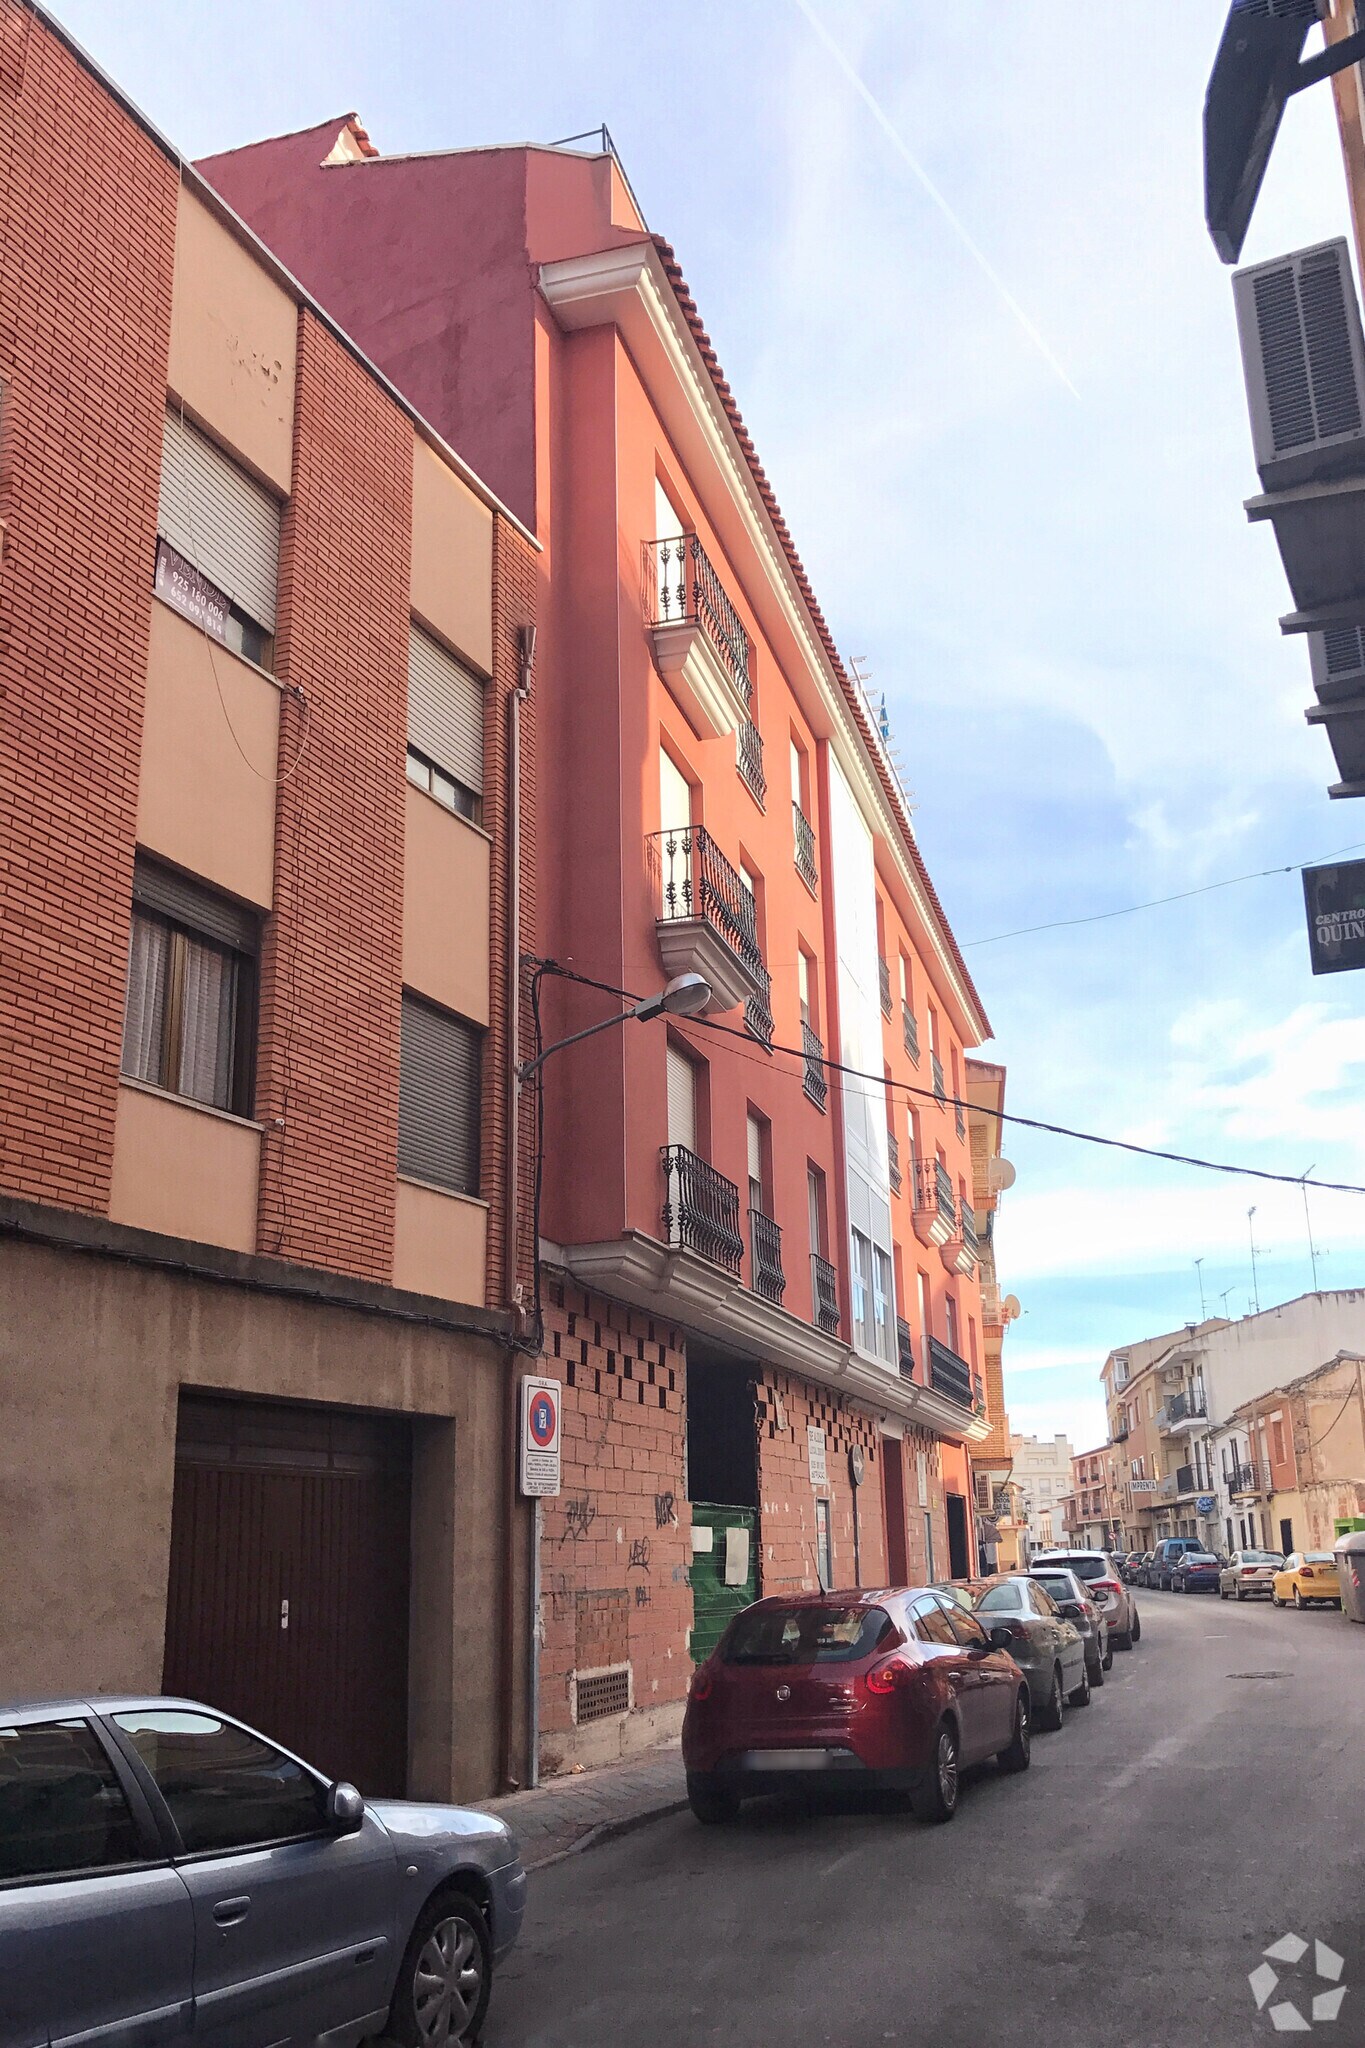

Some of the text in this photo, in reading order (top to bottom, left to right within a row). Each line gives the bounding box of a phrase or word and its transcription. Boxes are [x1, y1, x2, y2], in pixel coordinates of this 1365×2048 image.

[170, 586, 187, 607] 652
[172, 571, 224, 621] 925 180 006
[1315, 908, 1365, 925] CENTRO
[1316, 920, 1365, 946] QUIN
[1131, 1481, 1156, 1490] IMPRENTA
